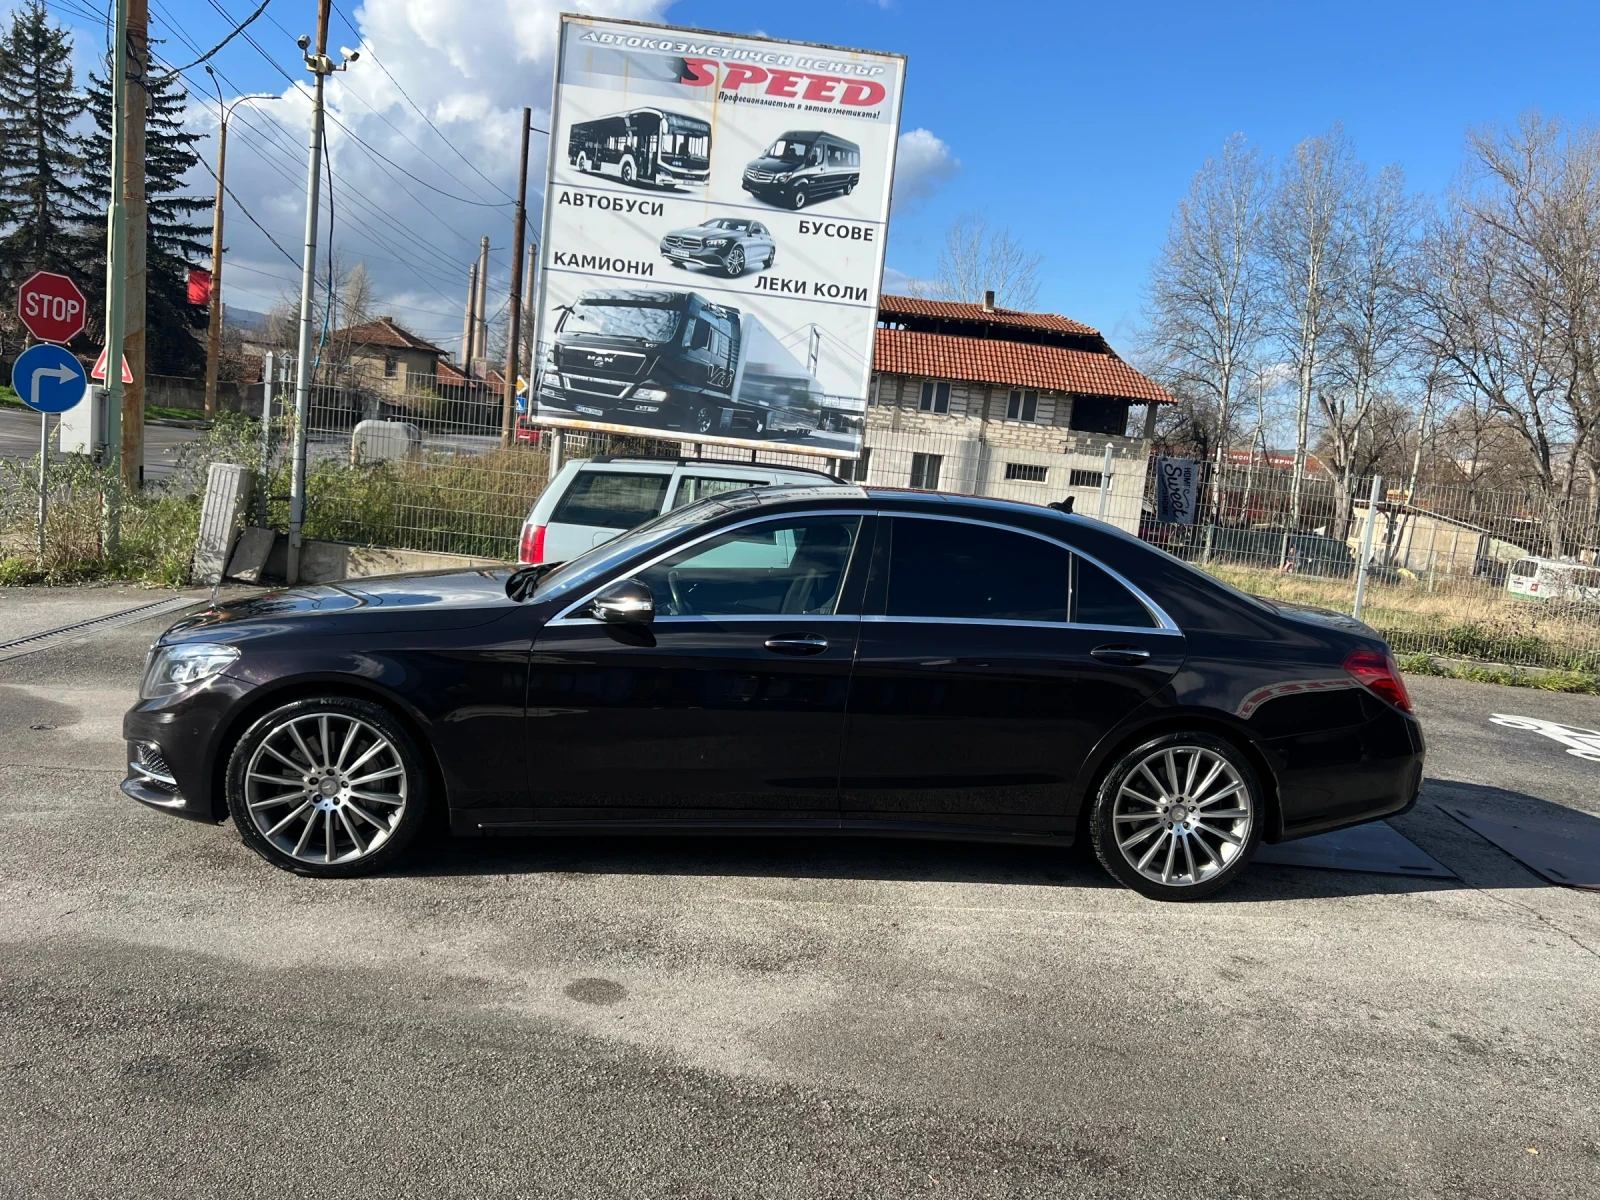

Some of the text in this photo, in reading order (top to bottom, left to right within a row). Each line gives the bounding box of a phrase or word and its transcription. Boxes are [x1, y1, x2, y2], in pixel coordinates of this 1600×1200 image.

[581, 32, 885, 76] АВТОКОЗМЕТИЧЕН ЦЕНТЪР
[680, 57, 886, 107] SPEED
[718, 91, 795, 109] Професионалистът
[804, 104, 880, 119] автокозметиката!
[559, 191, 664, 216] АВТОБУСИ
[799, 220, 874, 241] БУСОВЕ
[554, 251, 654, 276] КАМИОНИ
[755, 276, 868, 301] ЛЕКИ КОЛИ
[25, 291, 80, 322] STOP
[1164, 463, 1188, 518] Sweet
